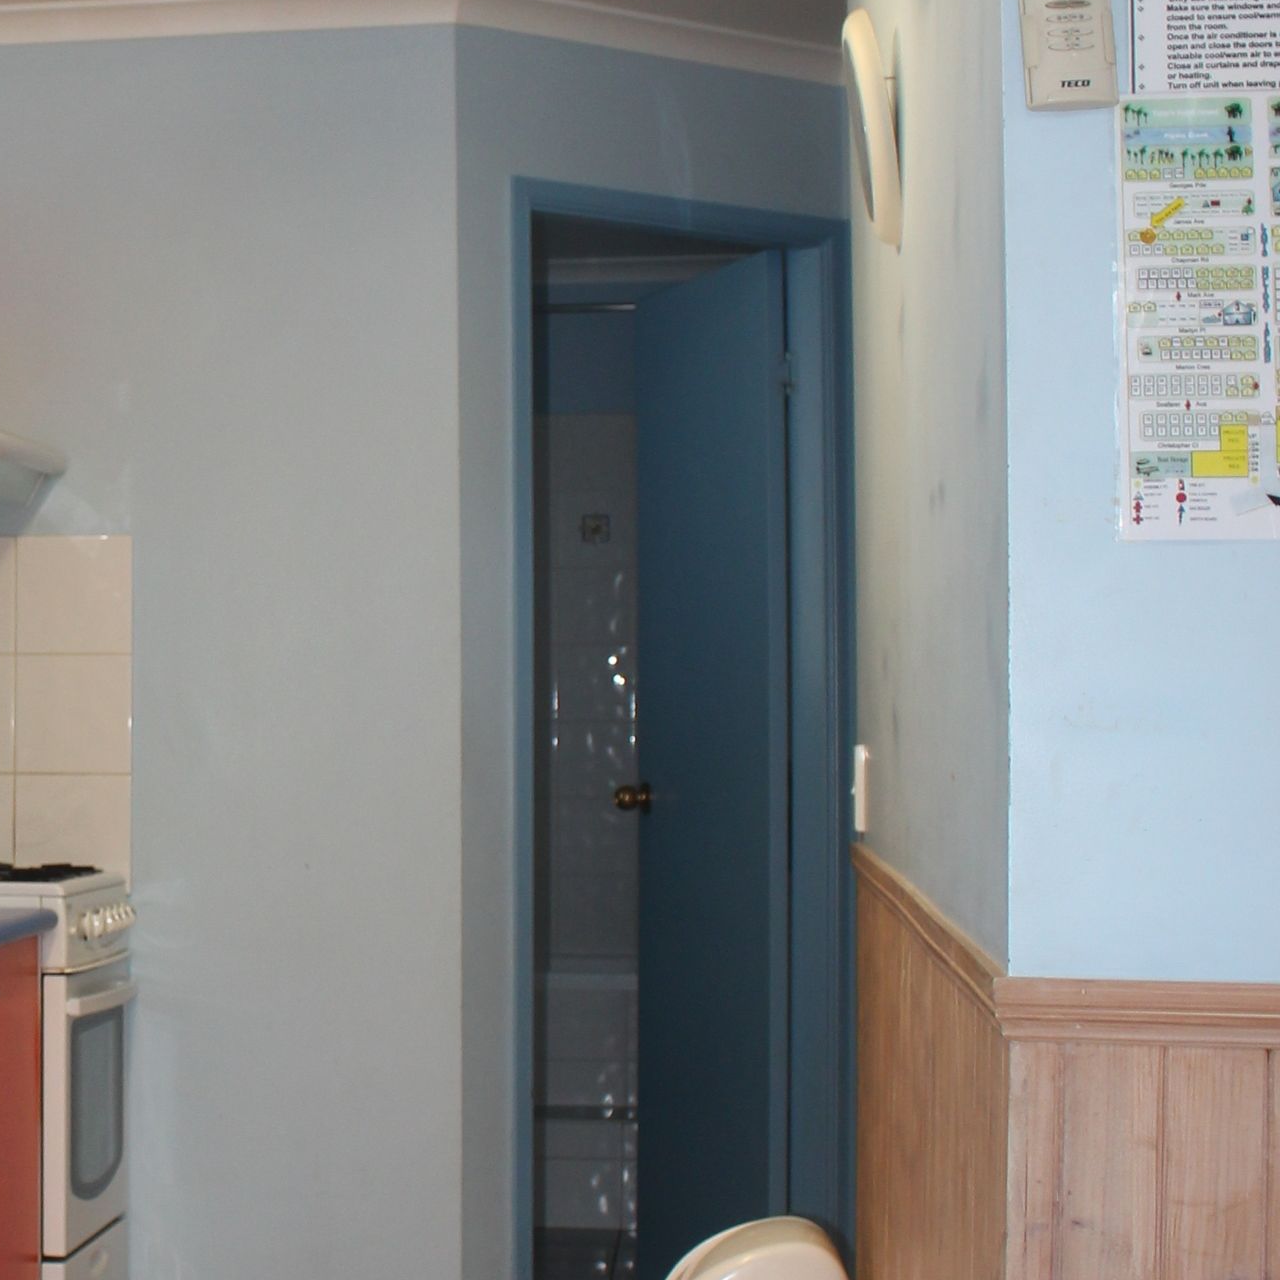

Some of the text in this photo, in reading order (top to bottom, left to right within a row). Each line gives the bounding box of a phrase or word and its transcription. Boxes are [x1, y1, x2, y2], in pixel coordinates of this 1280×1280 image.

[1167, 4, 1189, 12] Make
[1211, 3, 1225, 11] the
[1227, 2, 1264, 10] windows
[1167, 14, 1195, 22] closed
[1167, 23, 1187, 31] from
[1167, 33, 1189, 41] Once
[1220, 31, 1267, 39] conditioner
[1269, 30, 1277, 38] is
[1190, 42, 1206, 50] and
[1208, 42, 1231, 50] close
[1233, 41, 1246, 49] the
[1248, 40, 1273, 48] doors
[1167, 51, 1202, 60] valuable
[1167, 61, 1192, 70] Close
[1193, 61, 1203, 69] all
[1205, 60, 1240, 68] curtains
[1168, 72, 1176, 80] or
[1060, 79, 1090, 88] TECO
[1167, 80, 1187, 89] Turn
[1189, 80, 1201, 88] off
[1203, 80, 1219, 88] unit
[1221, 79, 1244, 87] when
[1246, 79, 1276, 88] leaving
